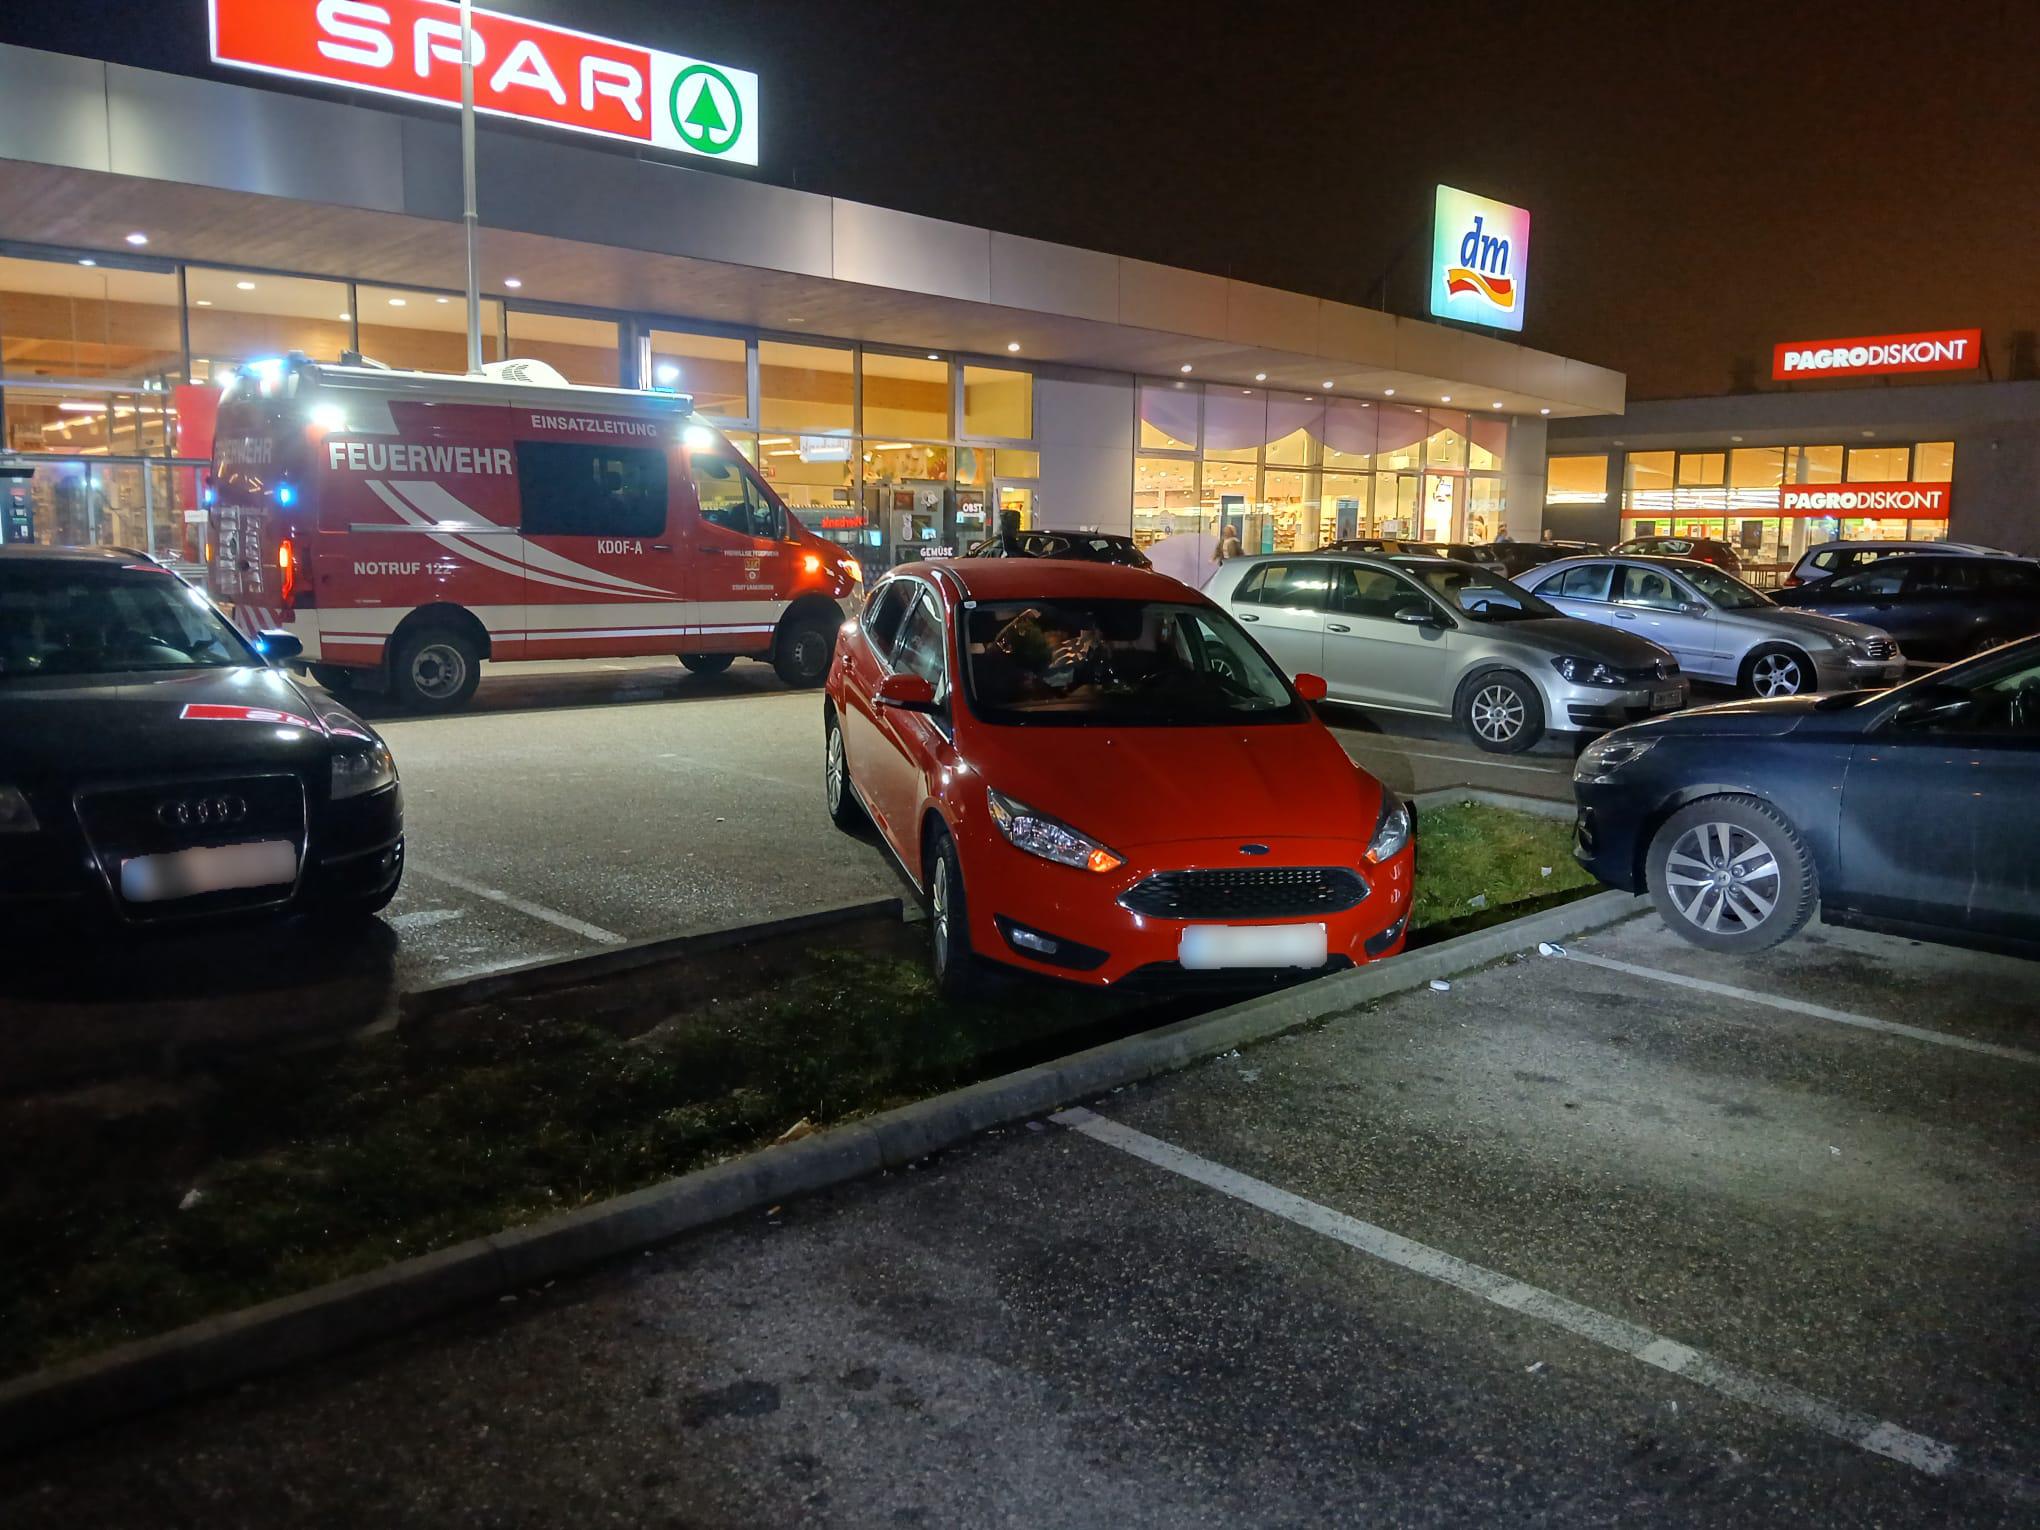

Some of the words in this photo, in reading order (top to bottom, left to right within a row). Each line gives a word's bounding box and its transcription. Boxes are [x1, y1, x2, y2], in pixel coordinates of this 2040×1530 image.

[316, 0, 643, 121] SPAR
[1461, 216, 1509, 275] dm
[531, 415, 657, 437] EINSATZLEITUNG
[328, 442, 513, 475] FEUERWEHR
[597, 540, 643, 555] KDOF-A
[920, 546, 953, 557] GEMÜSE
[353, 562, 420, 575] NOTRUF
